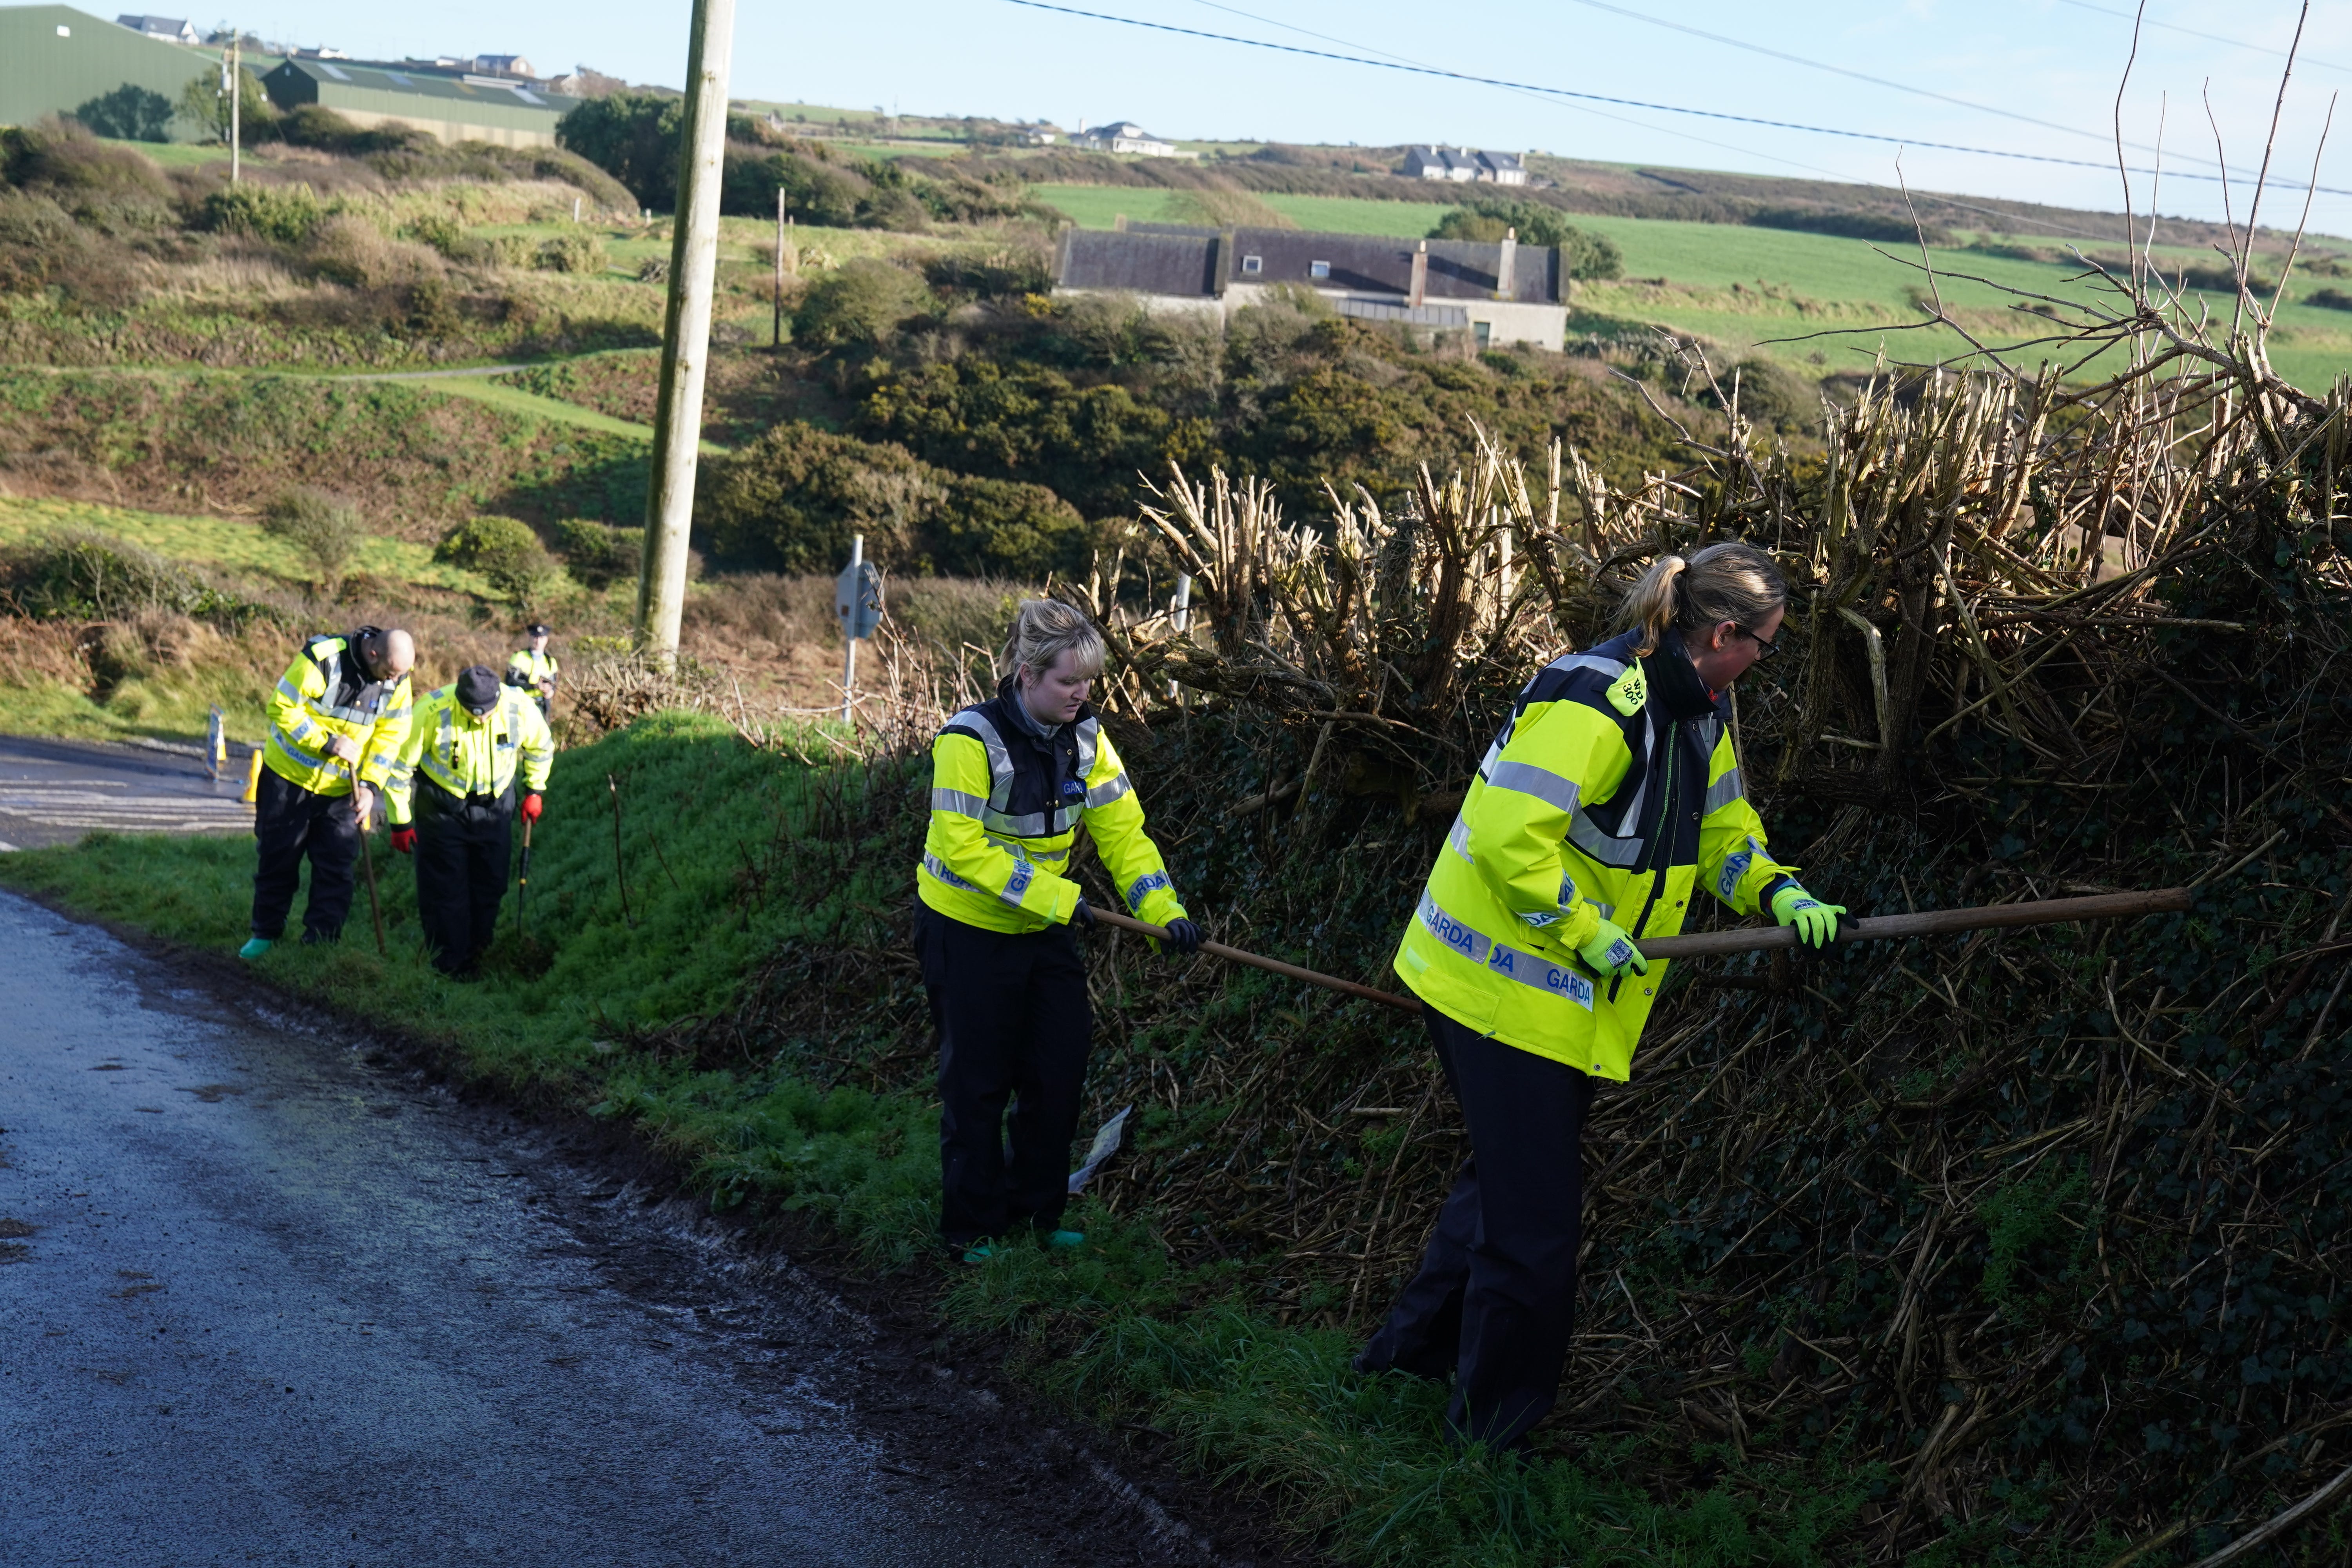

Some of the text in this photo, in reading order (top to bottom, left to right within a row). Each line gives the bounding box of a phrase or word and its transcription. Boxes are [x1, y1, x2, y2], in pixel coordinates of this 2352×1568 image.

[1623, 684, 1638, 705] 300
[1634, 678, 1643, 700] WD
[1427, 905, 1472, 953] GARDA
[1547, 969, 1590, 1004] GARDA
